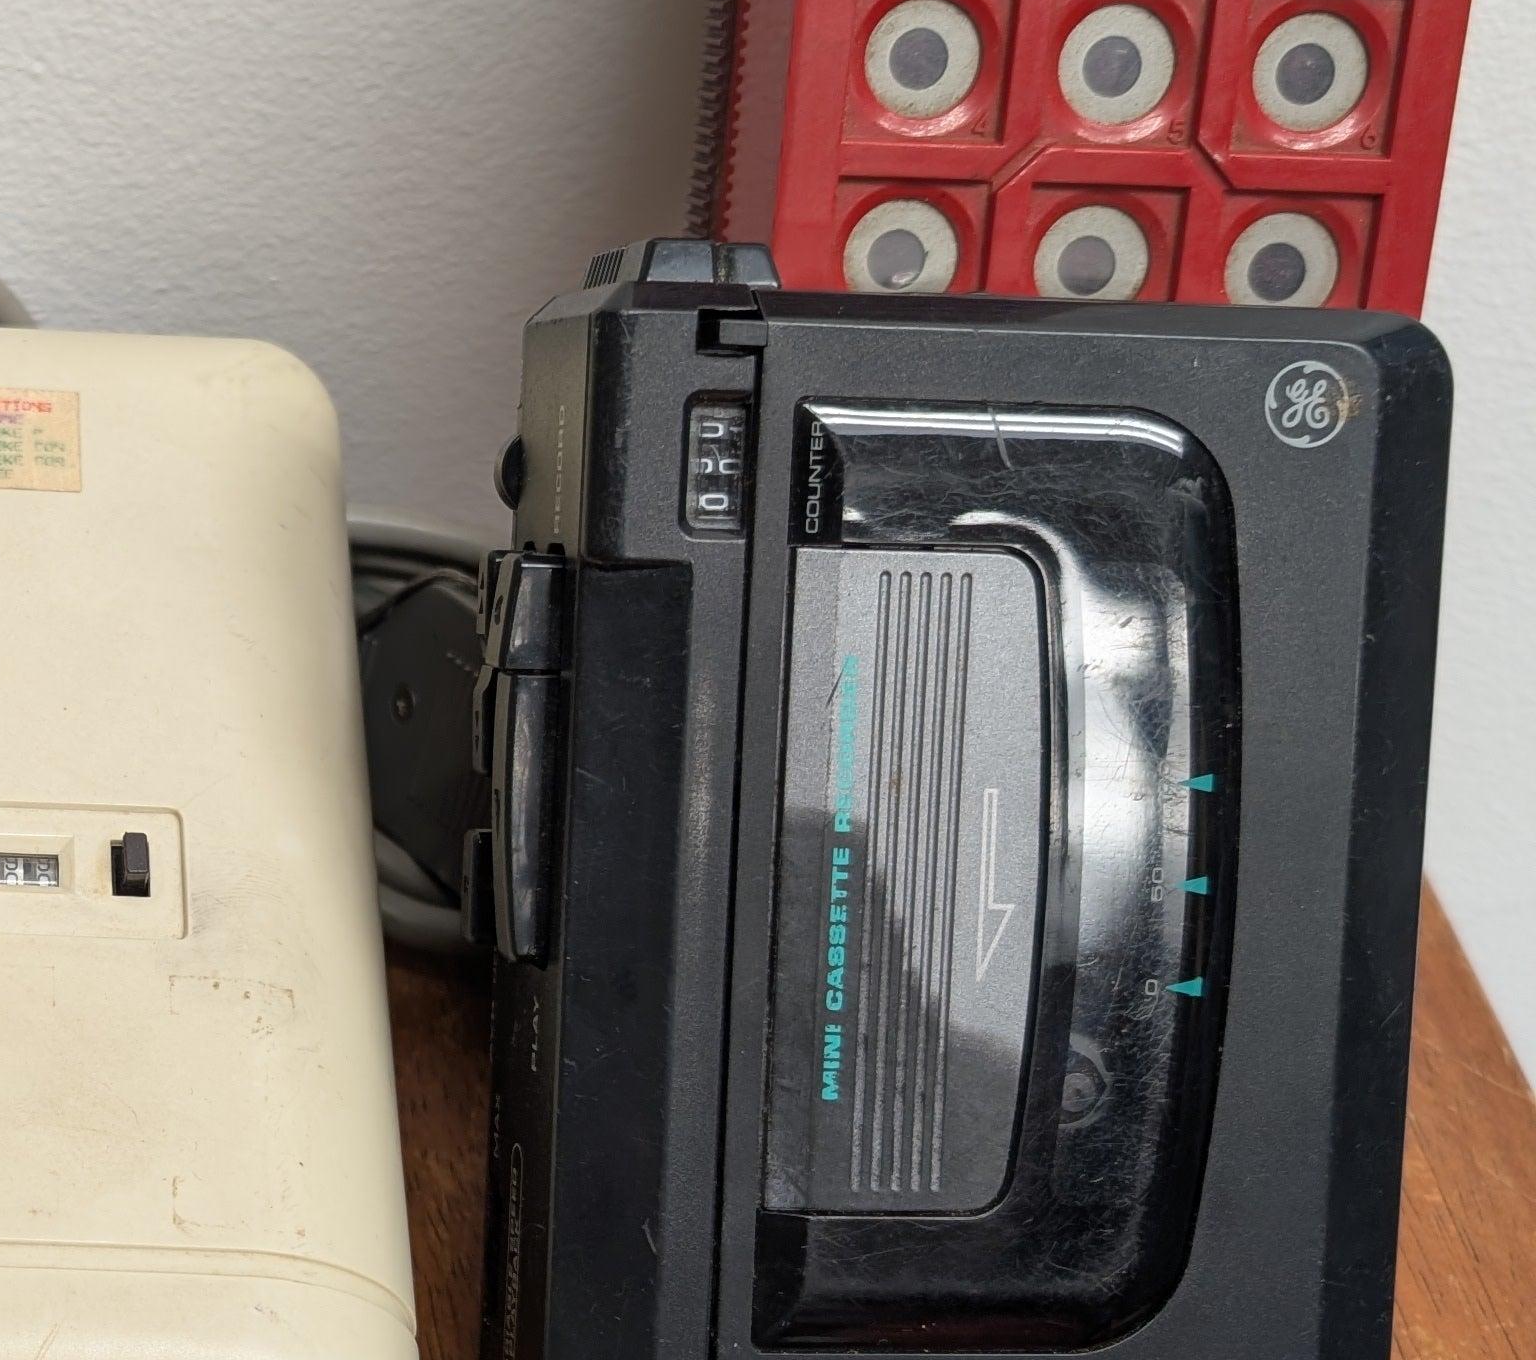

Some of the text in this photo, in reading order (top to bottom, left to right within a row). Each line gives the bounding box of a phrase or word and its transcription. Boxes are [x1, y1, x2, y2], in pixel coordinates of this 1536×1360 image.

[971, 111, 987, 139] 4
[1166, 119, 1185, 143] 5
[1360, 125, 1377, 150] 6
[805, 421, 824, 534] COUNTER
[821, 653, 859, 1102] MINI CASSETTE RECORDER
